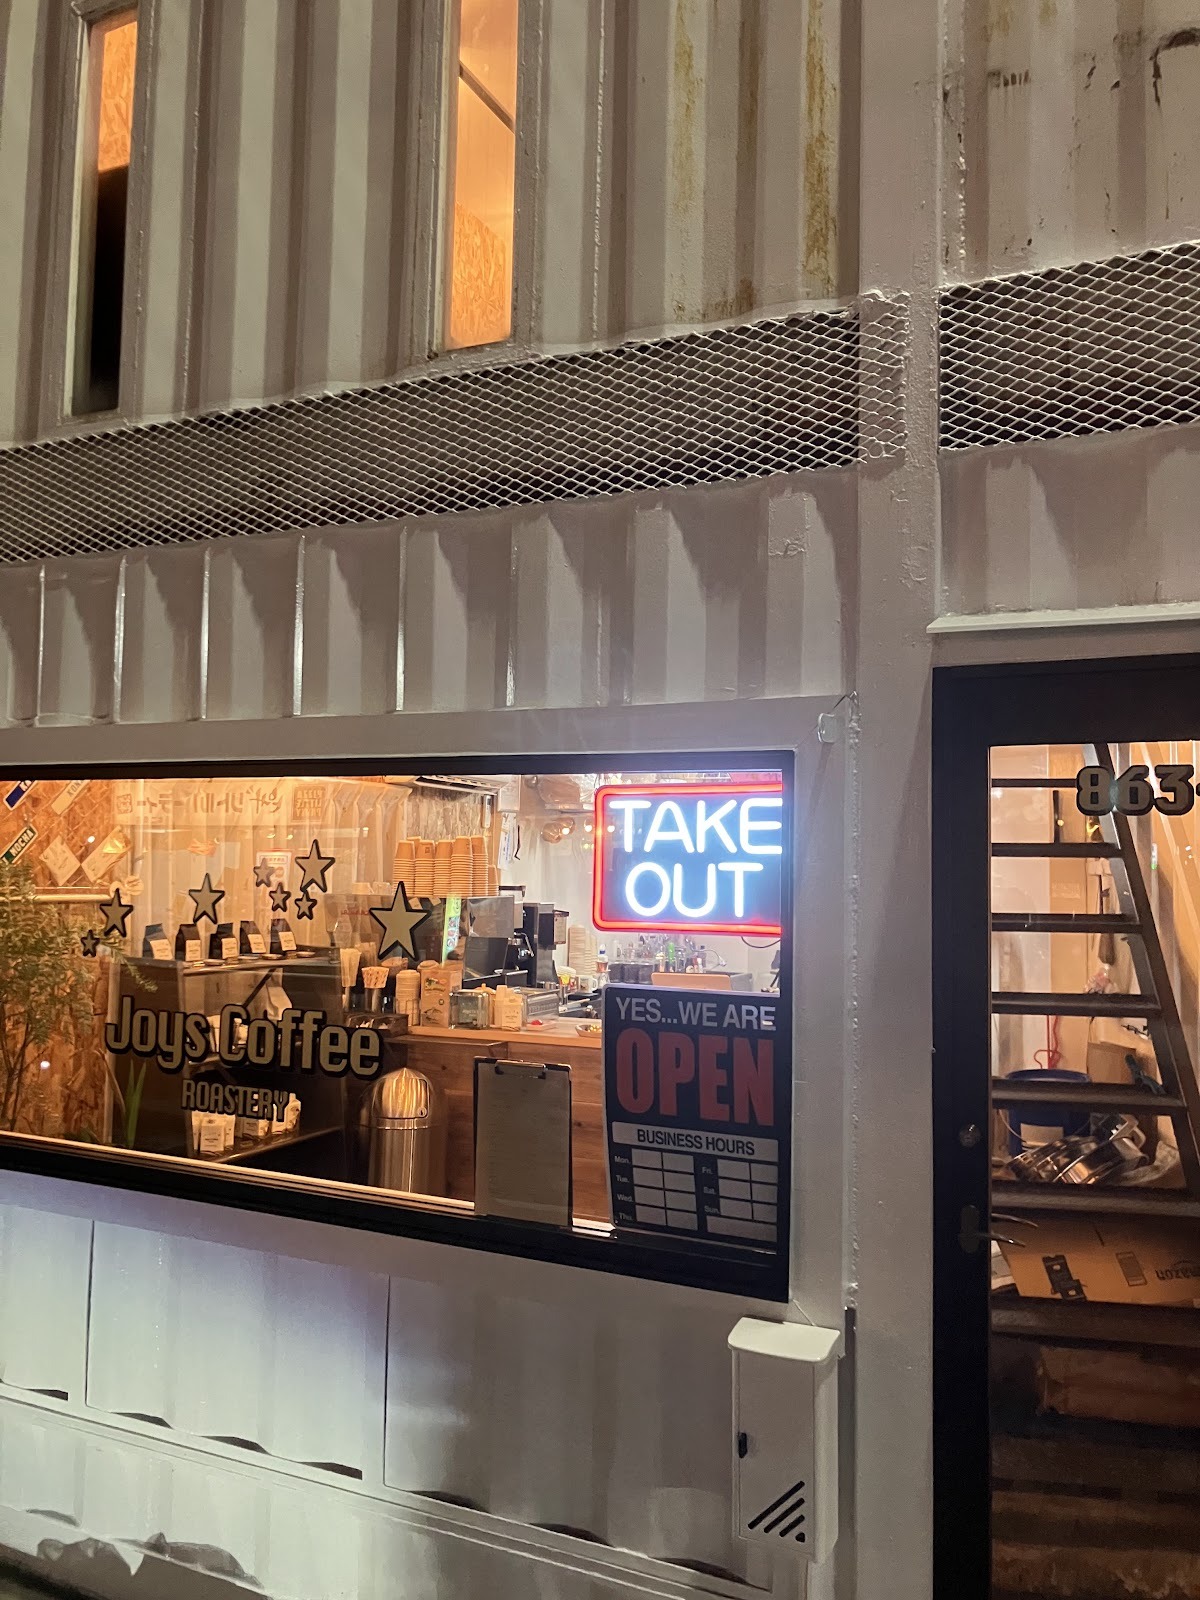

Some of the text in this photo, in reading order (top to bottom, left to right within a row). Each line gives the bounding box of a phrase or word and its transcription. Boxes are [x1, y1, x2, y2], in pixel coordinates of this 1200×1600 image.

[1076, 764, 1200, 816] 863
[9, 829, 34, 857] MOCHA
[608, 798, 783, 854] TAKE
[625, 861, 763, 918] OUT
[104, 994, 384, 1080] Joys Coffee
[722, 1004, 777, 1031] ARE
[616, 1027, 775, 1127] OPEN
[181, 1080, 290, 1123] ROASTERY
[614, 1155, 631, 1165] Mon.
[637, 1128, 755, 1156] BUSINESS HOURS
